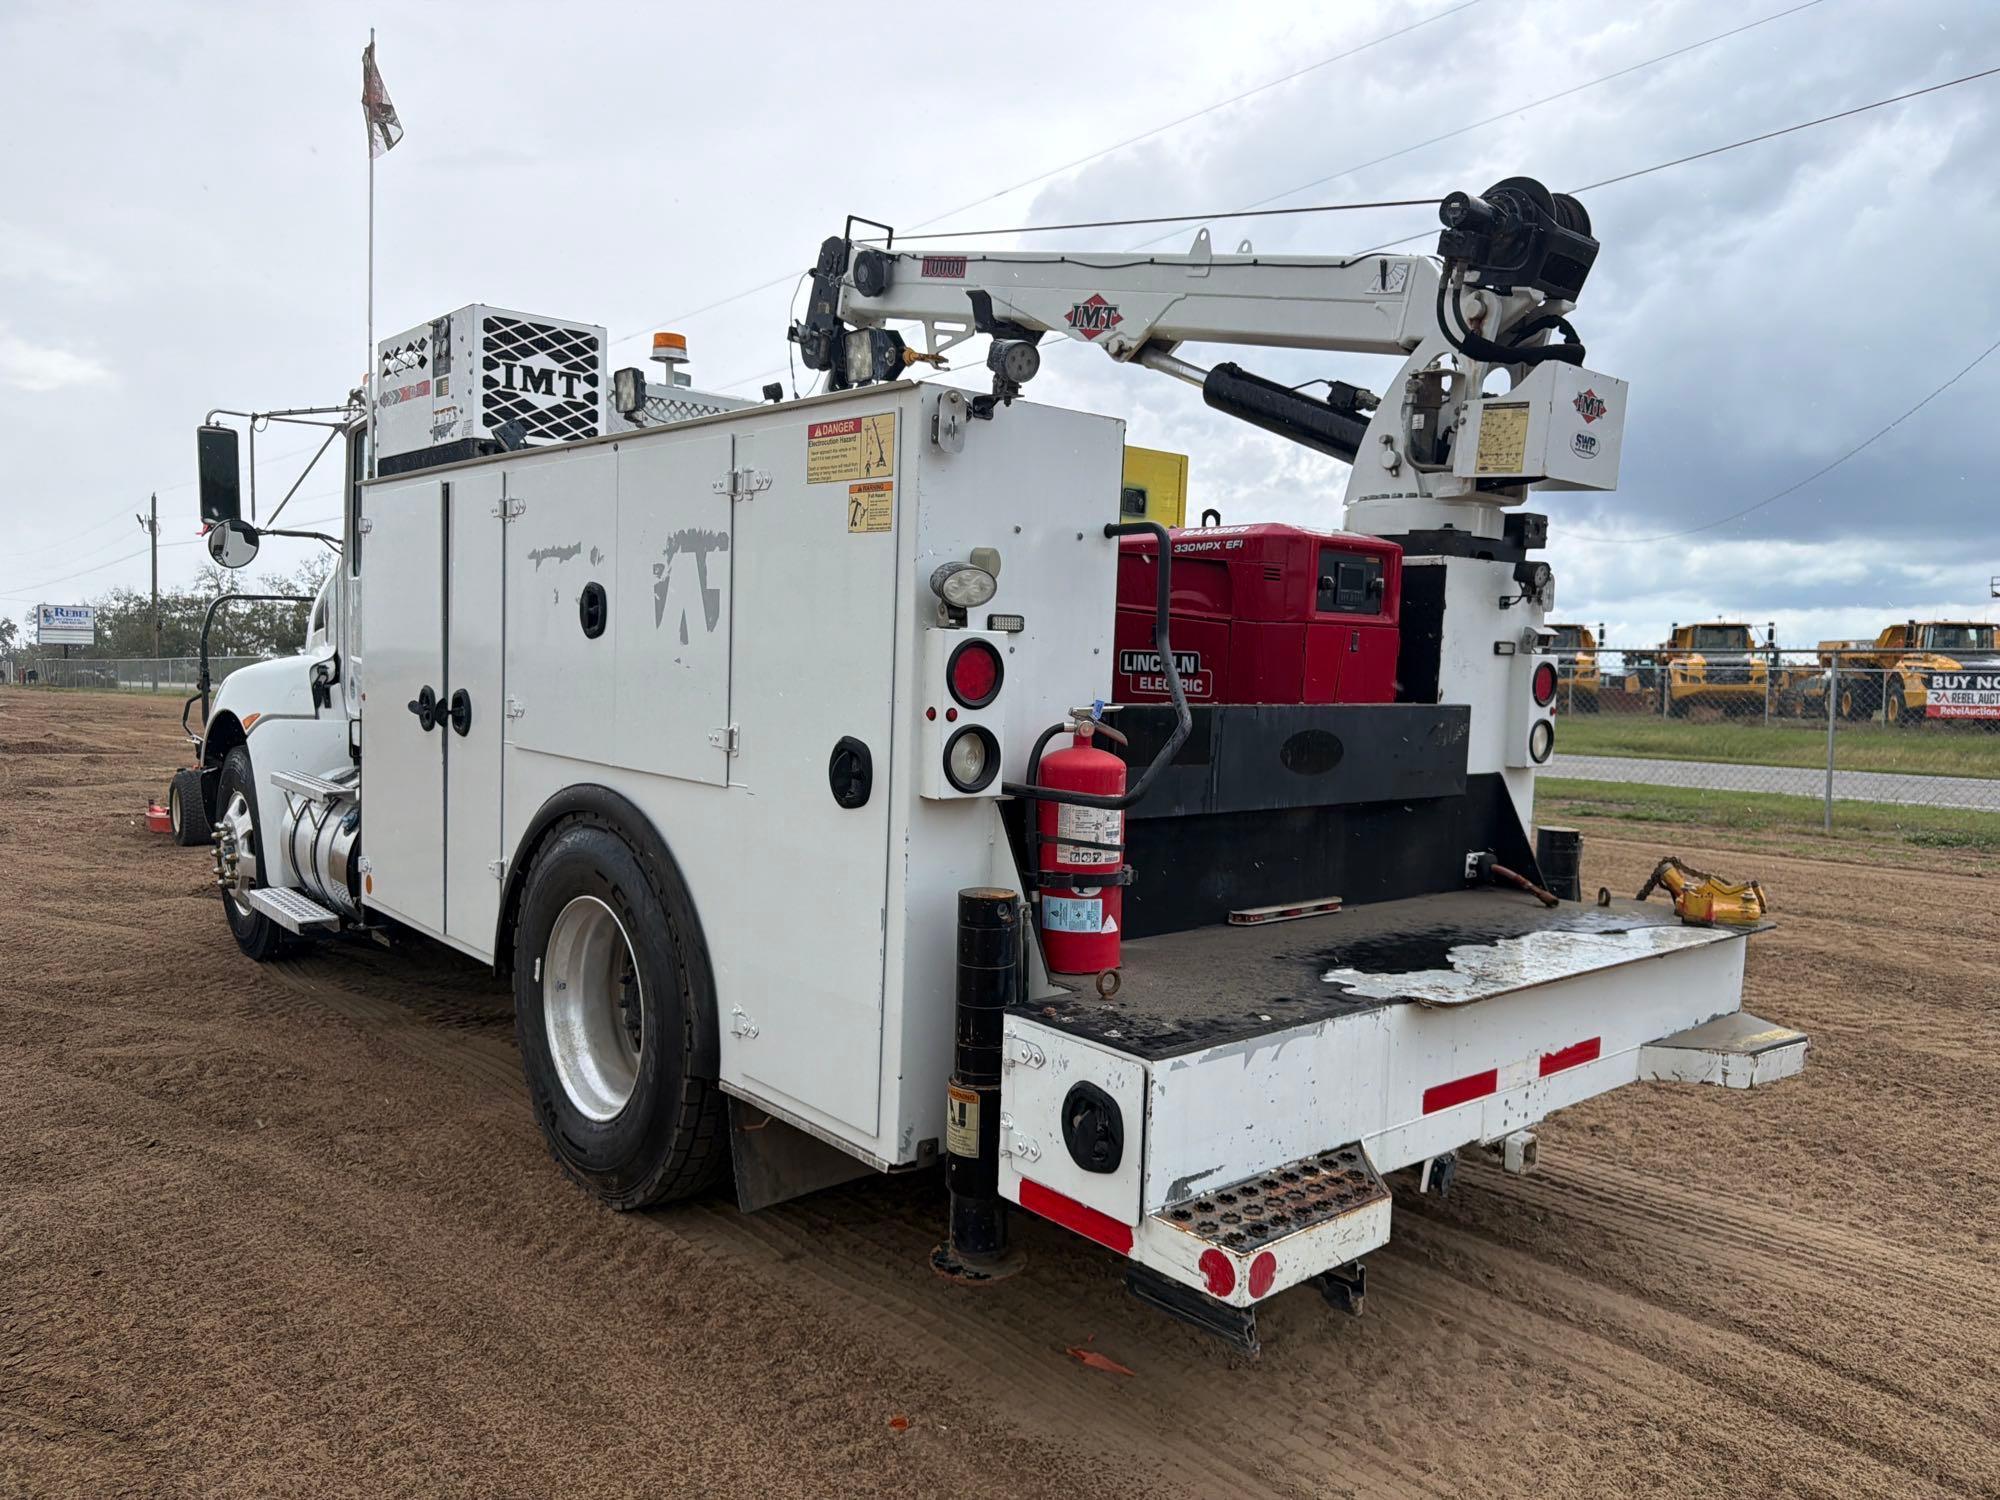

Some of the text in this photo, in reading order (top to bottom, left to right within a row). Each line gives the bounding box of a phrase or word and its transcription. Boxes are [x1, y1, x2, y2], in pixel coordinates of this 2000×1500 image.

[924, 258, 965, 277] 10000
[1070, 304, 1118, 329] IMT
[501, 361, 582, 399] IMT
[1577, 393, 1605, 419] IMT
[822, 421, 855, 435] DANGER
[1180, 525, 1250, 537] RANGER
[1174, 539, 1243, 553] 330MPX EFI
[1124, 654, 1195, 673] LINCLN
[1140, 676, 1203, 692] ELECRIC
[1932, 675, 1971, 689] BUY
[1951, 692, 1975, 704] REBEL
